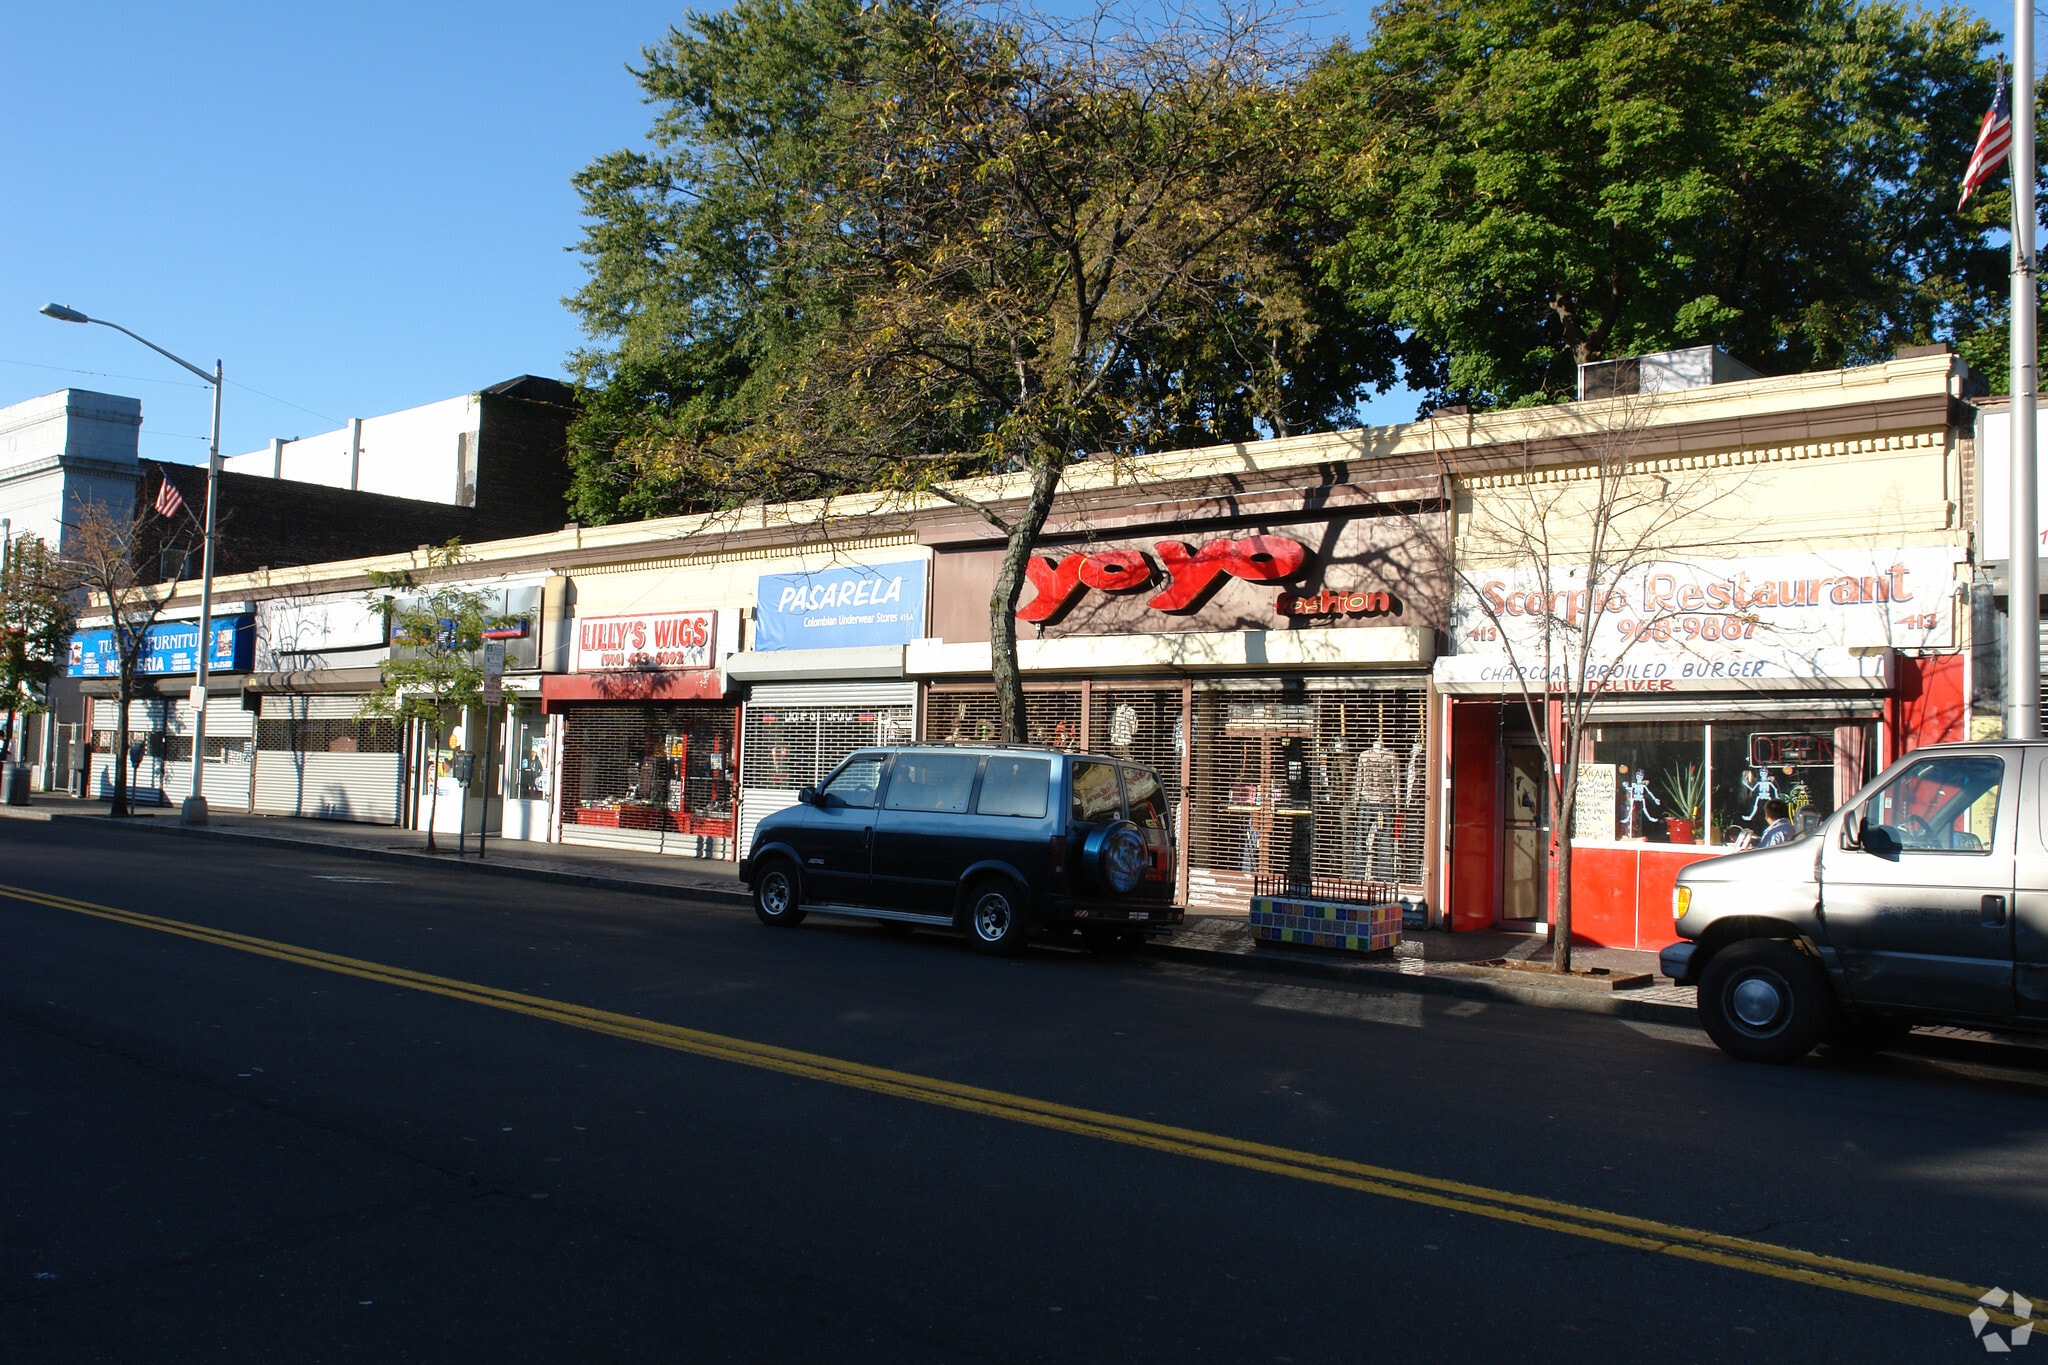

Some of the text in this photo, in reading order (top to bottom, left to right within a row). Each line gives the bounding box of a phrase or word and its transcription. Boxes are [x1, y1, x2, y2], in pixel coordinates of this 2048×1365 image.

[777, 576, 903, 613] PASARELA
[1482, 562, 1914, 628] Scorpio Restaurant
[803, 617, 838, 628] Colombian
[838, 614, 875, 626] Underwear
[876, 612, 898, 624] Stores
[1617, 615, 1760, 643] 968-9887
[1894, 612, 1939, 632] 413
[98, 639, 113, 654] TU
[146, 631, 215, 651] FURNITUE
[581, 617, 709, 651] LILLY'S WIGS
[1467, 626, 1498, 642] 413
[601, 652, 625, 667] (914)
[1584, 662, 1667, 679] BROILED
[1682, 660, 1768, 678] BURGER
[1550, 679, 1676, 693] WE DELIVER
[1753, 735, 1834, 764] OPEN
